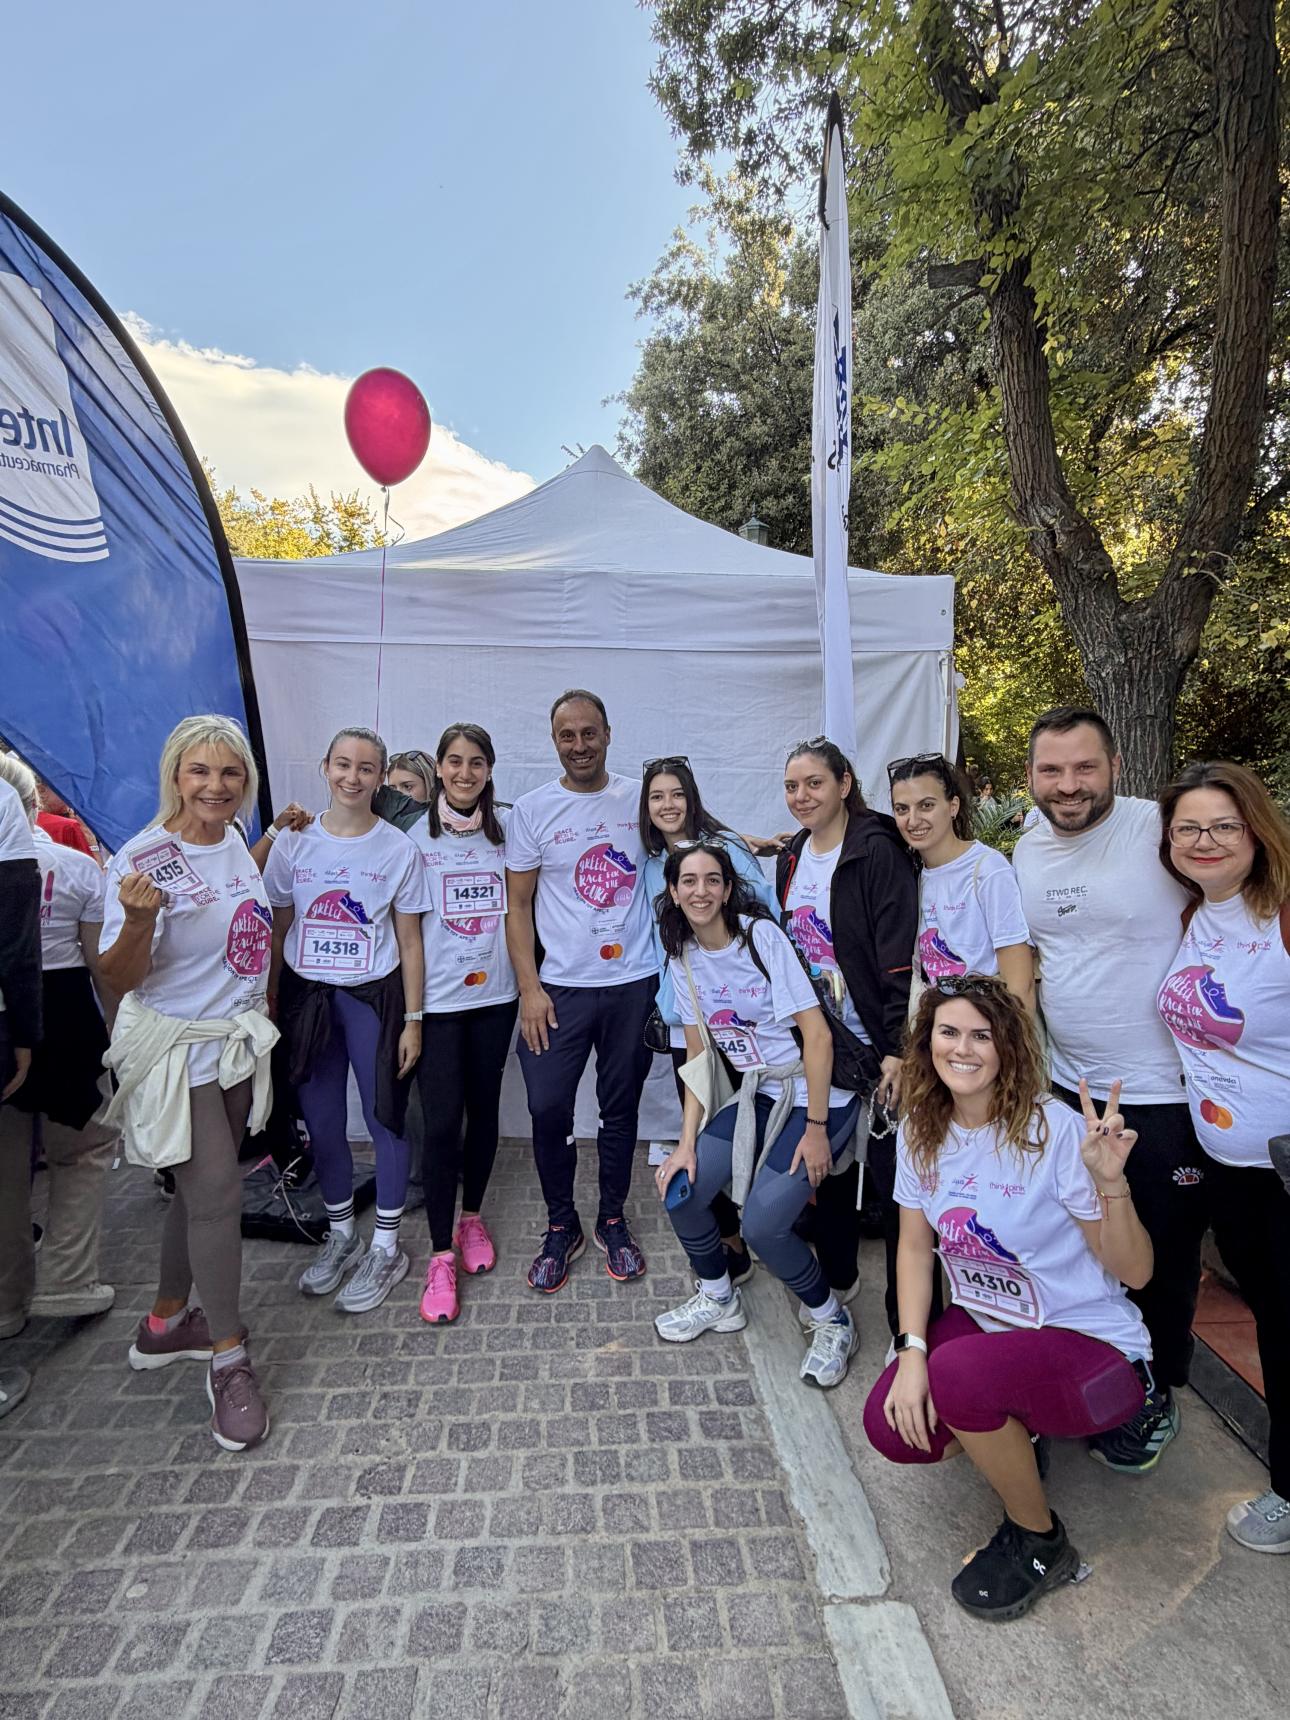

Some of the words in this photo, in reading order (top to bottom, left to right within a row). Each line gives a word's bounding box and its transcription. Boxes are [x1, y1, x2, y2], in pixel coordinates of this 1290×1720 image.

[453, 886, 494, 900] 14321
[312, 940, 360, 956] 14318
[960, 1268, 1022, 1297] 14310
